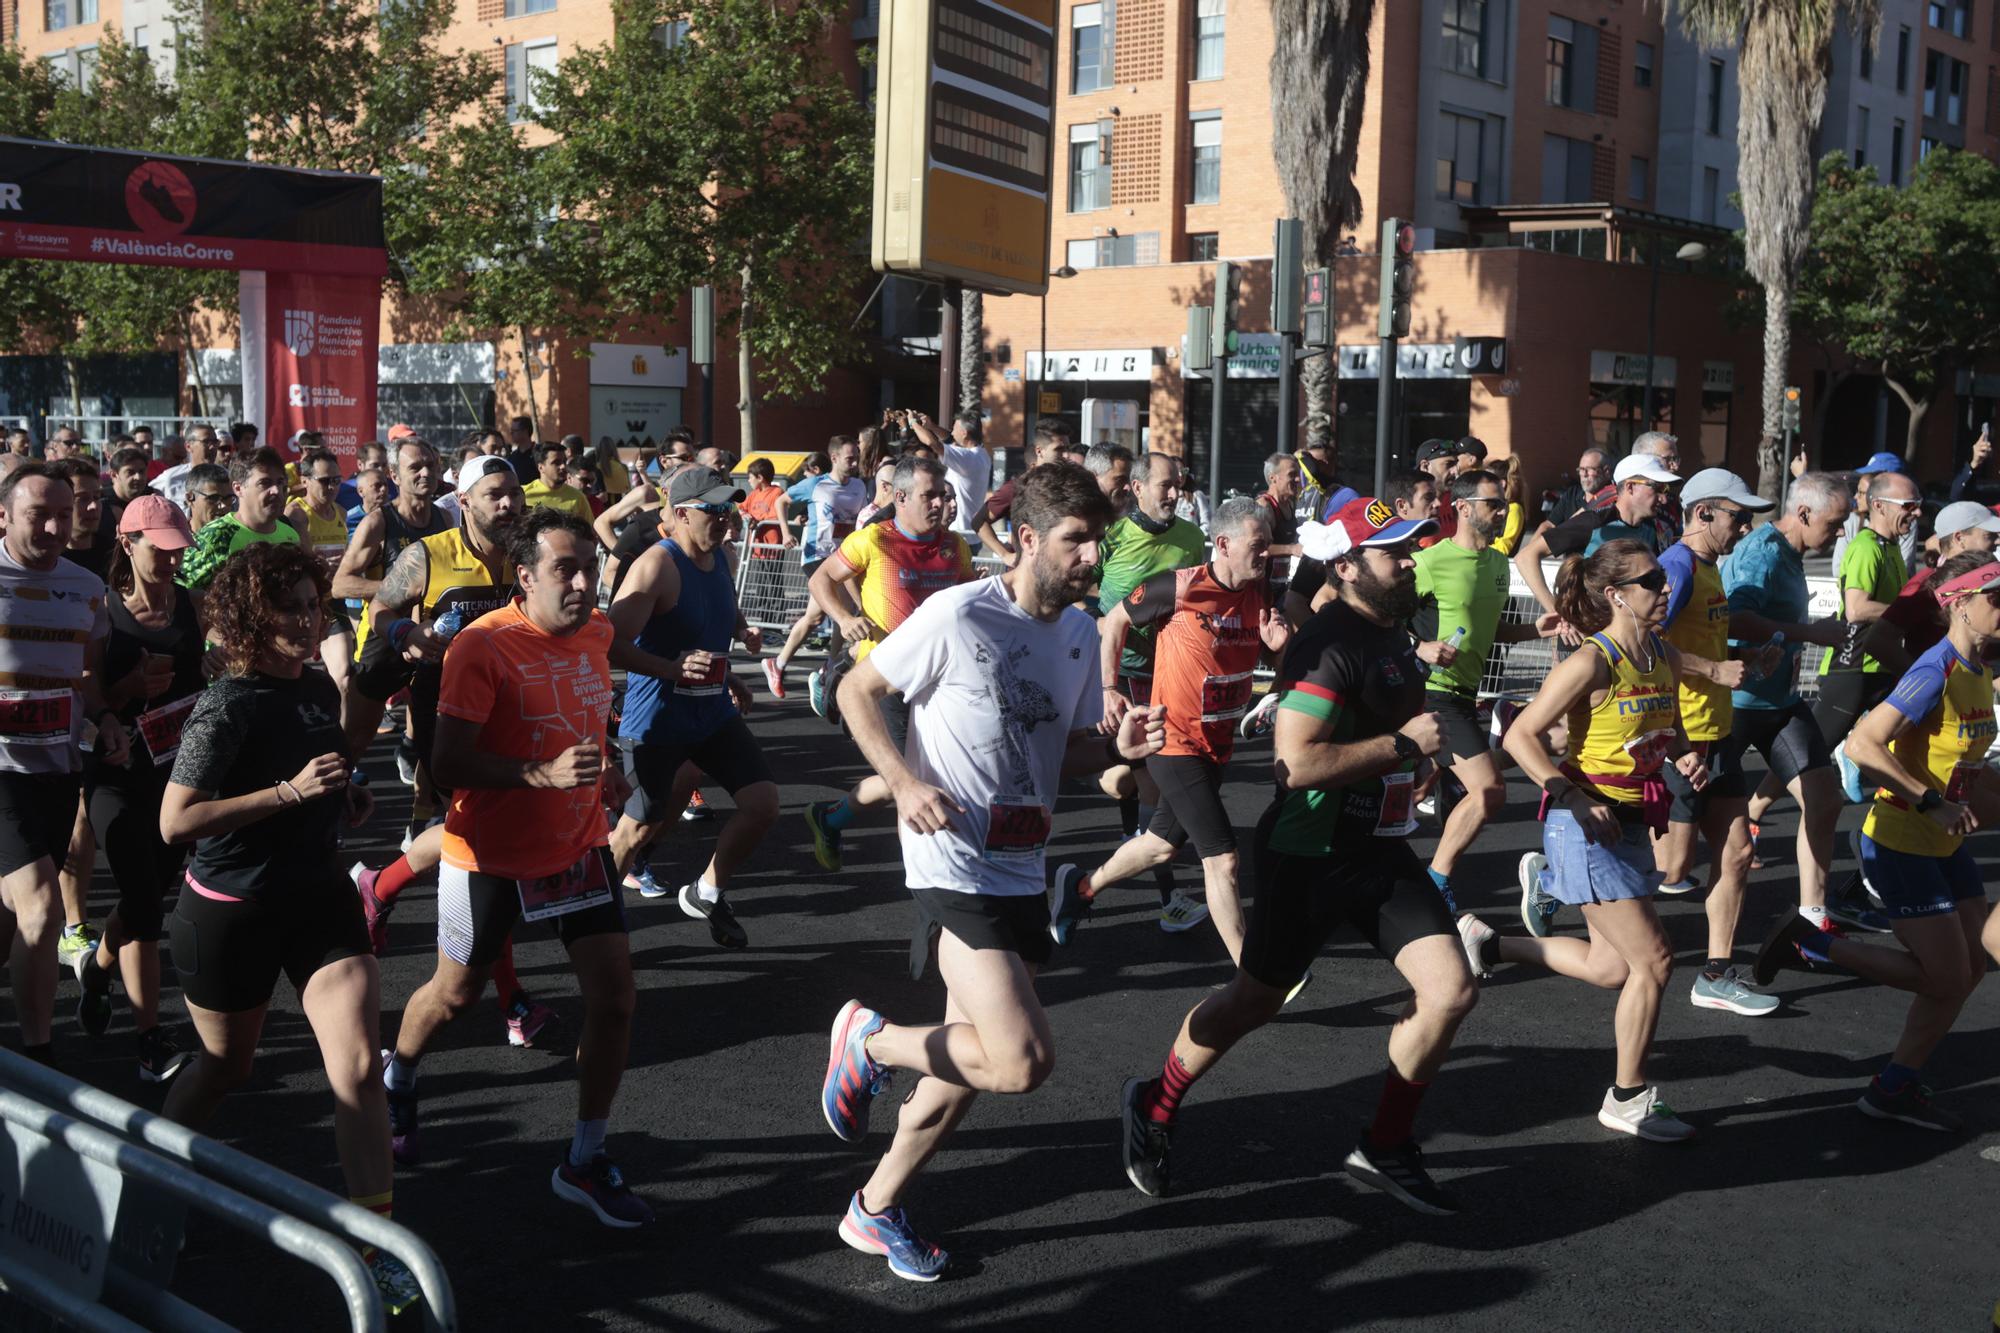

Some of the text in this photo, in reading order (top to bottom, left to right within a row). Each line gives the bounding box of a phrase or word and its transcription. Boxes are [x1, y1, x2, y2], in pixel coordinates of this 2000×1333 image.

[91, 236, 234, 260] #ValènciaCorre
[318, 336, 363, 347] Municipal
[1240, 342, 1281, 356] Urban
[1228, 356, 1280, 373] unning
[311, 385, 340, 396] caixa
[312, 396, 357, 408] popular
[573, 680, 605, 697] DIVINA
[1618, 695, 1672, 716] runner
[1347, 793, 1374, 808] THE
[11, 1199, 95, 1275] RUNNING
